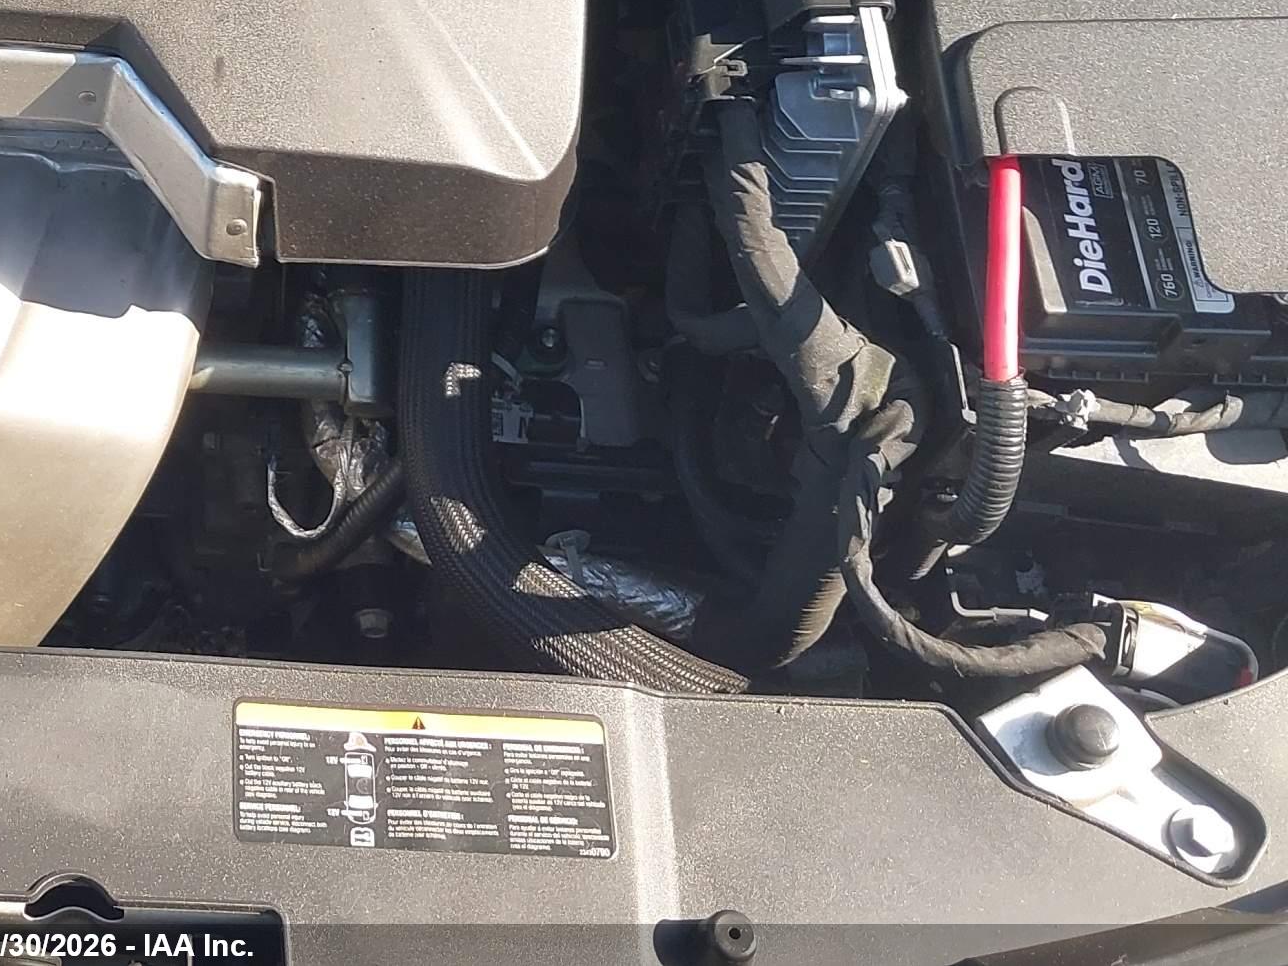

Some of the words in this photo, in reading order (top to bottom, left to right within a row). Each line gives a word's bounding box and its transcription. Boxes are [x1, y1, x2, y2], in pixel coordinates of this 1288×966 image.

[1136, 170, 1150, 184] 70
[1050, 158, 1113, 295] DieHard
[1146, 218, 1161, 239] 120
[1160, 273, 1178, 297] 760
